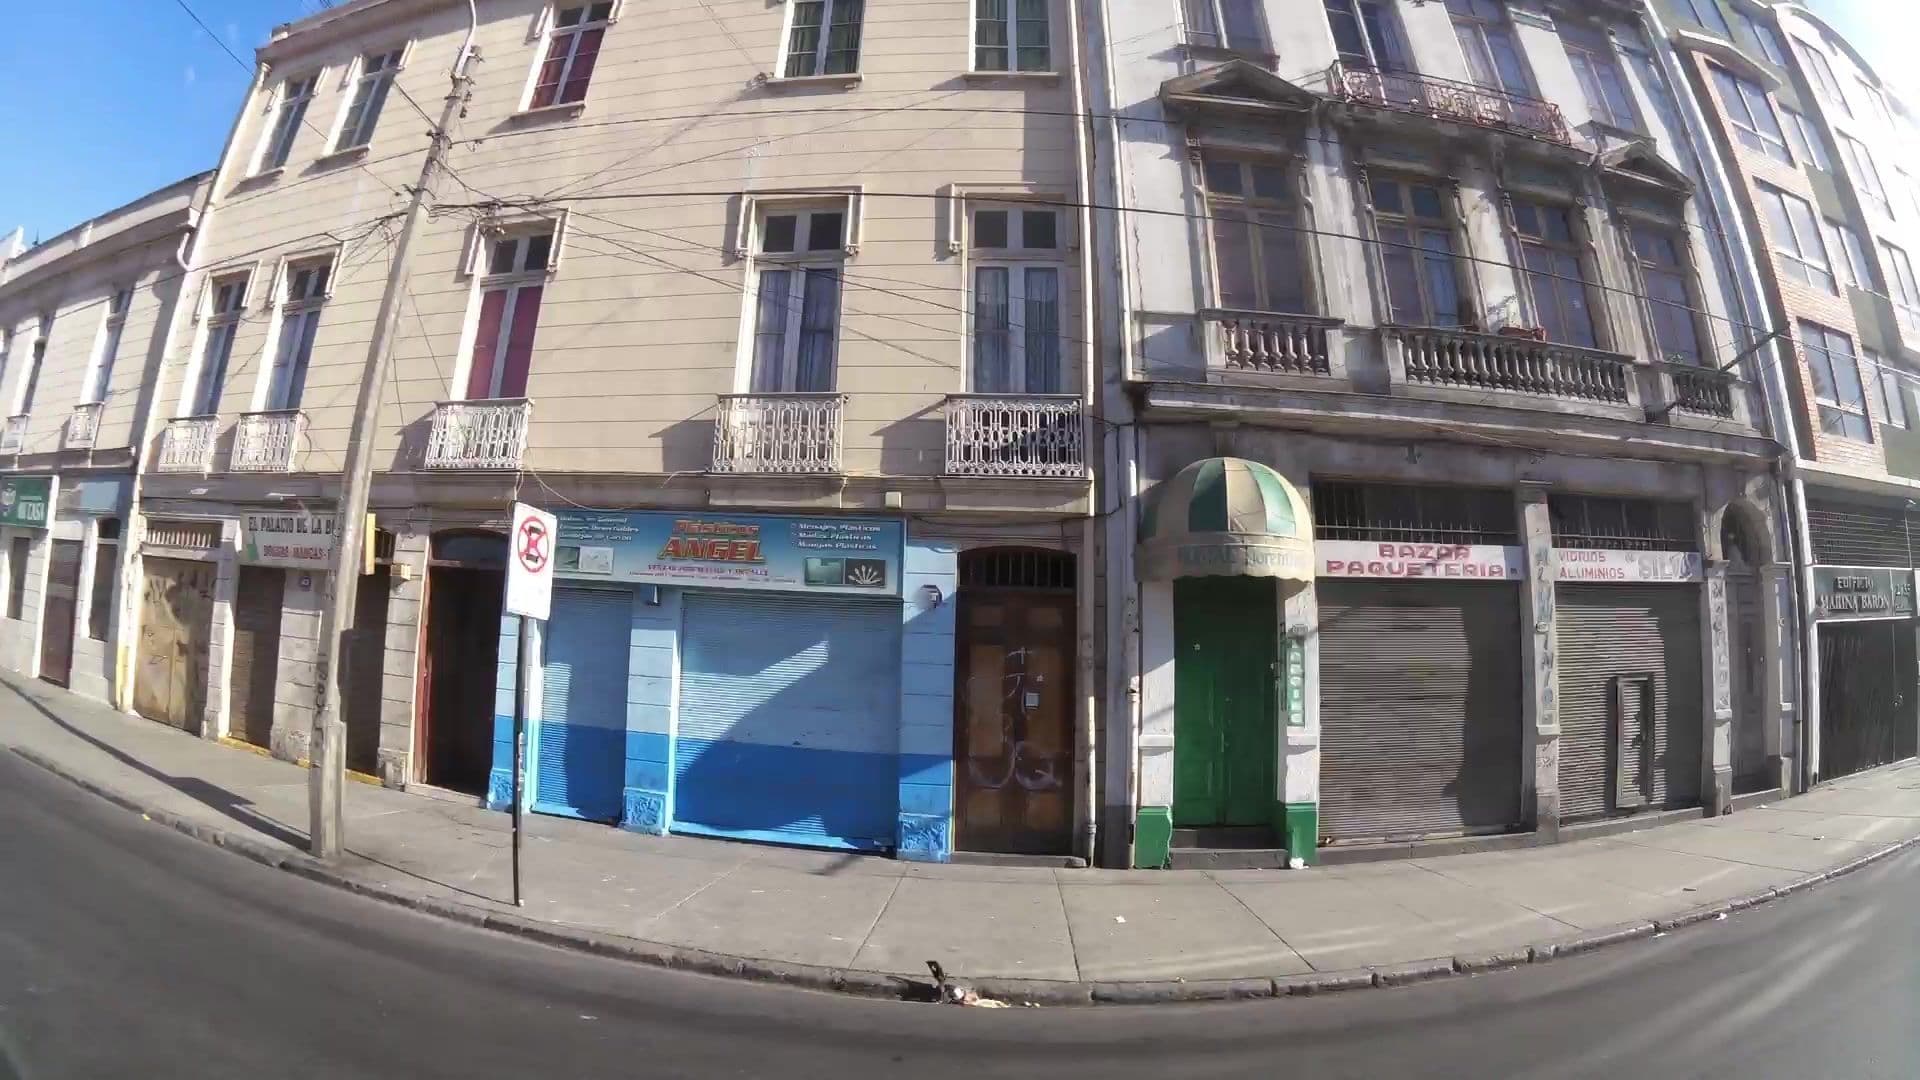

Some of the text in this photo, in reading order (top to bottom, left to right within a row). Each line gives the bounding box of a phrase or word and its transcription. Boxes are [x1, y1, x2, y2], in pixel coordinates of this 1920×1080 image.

[248, 516, 258, 531] EL
[261, 517, 294, 533] PALACIO
[312, 519, 322, 534] LA
[656, 536, 768, 562] ANGEL
[1377, 543, 1472, 560] BAZAR
[1558, 550, 1607, 563] VIDRIOS
[1326, 559, 1505, 577] PAQUETERIA
[1559, 566, 1626, 580] ALUMINIOS
